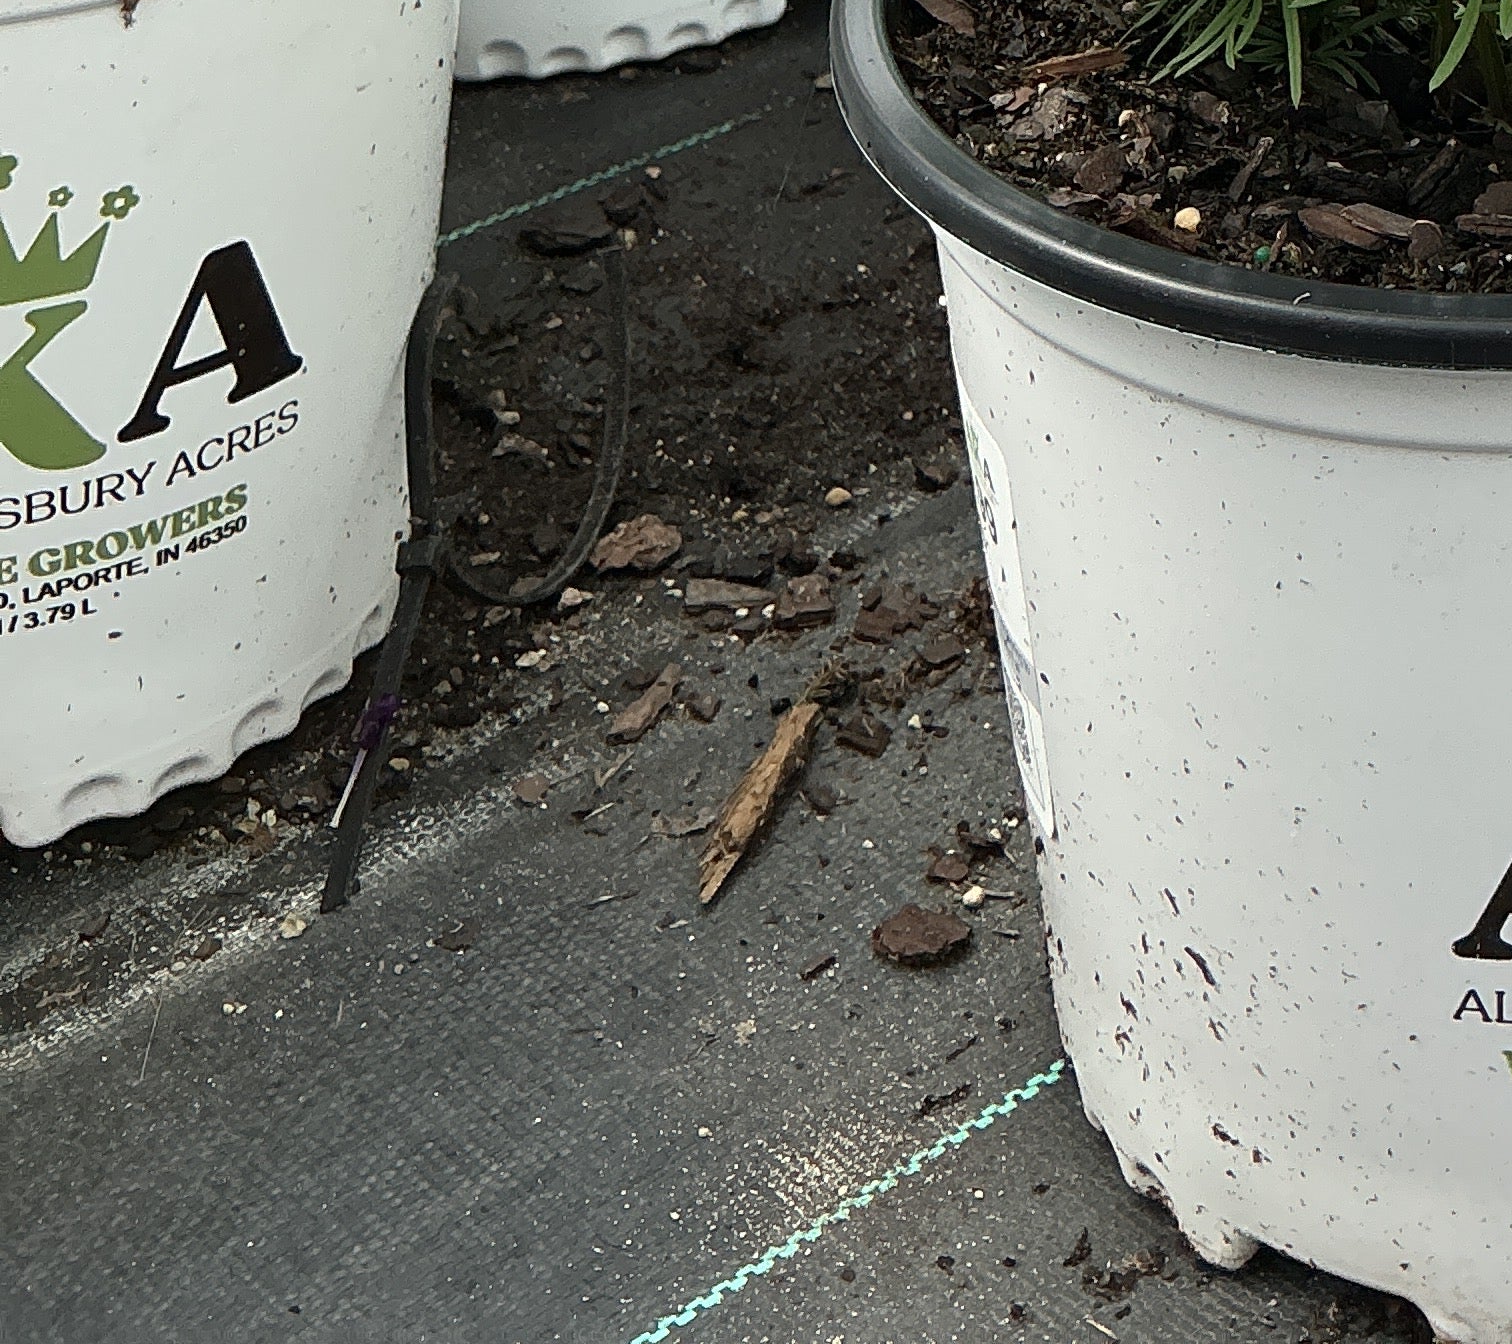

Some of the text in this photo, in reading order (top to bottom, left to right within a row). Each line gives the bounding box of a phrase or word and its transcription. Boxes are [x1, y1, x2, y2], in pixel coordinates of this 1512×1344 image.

[166, 400, 299, 486] ACRES
[22, 557, 149, 604] LAPORTE,
[156, 543, 180, 566] IN
[185, 515, 247, 553] 46350
[27, 483, 248, 576] GROWERS
[24, 603, 75, 628] 3.79
[82, 598, 97, 615] L
